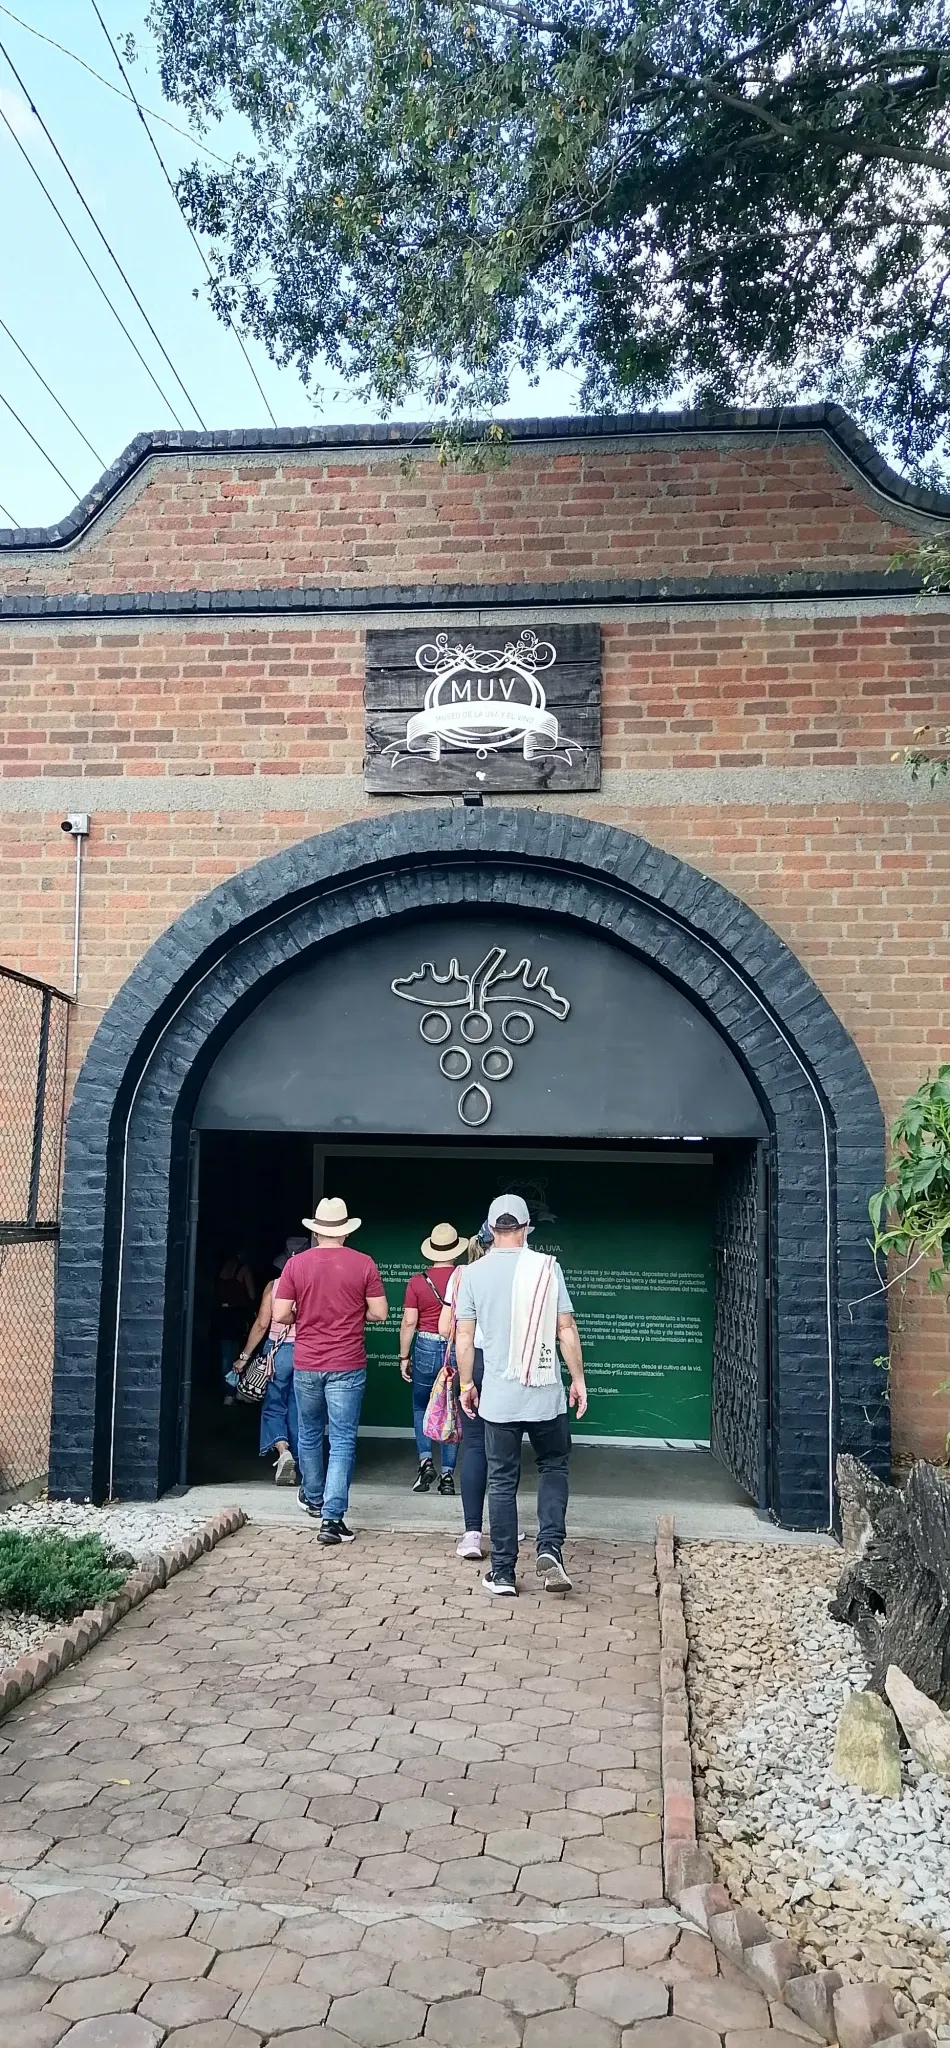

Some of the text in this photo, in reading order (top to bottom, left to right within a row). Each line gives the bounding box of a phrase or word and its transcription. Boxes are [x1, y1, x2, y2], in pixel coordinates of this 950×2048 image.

[451, 678, 516, 702] MUV
[435, 712, 461, 722] MUSEO
[507, 712, 515, 720] EL
[517, 712, 535, 724] VINO
[616, 1313, 628, 1321] llega
[599, 1387, 620, 1395] Grajales.
